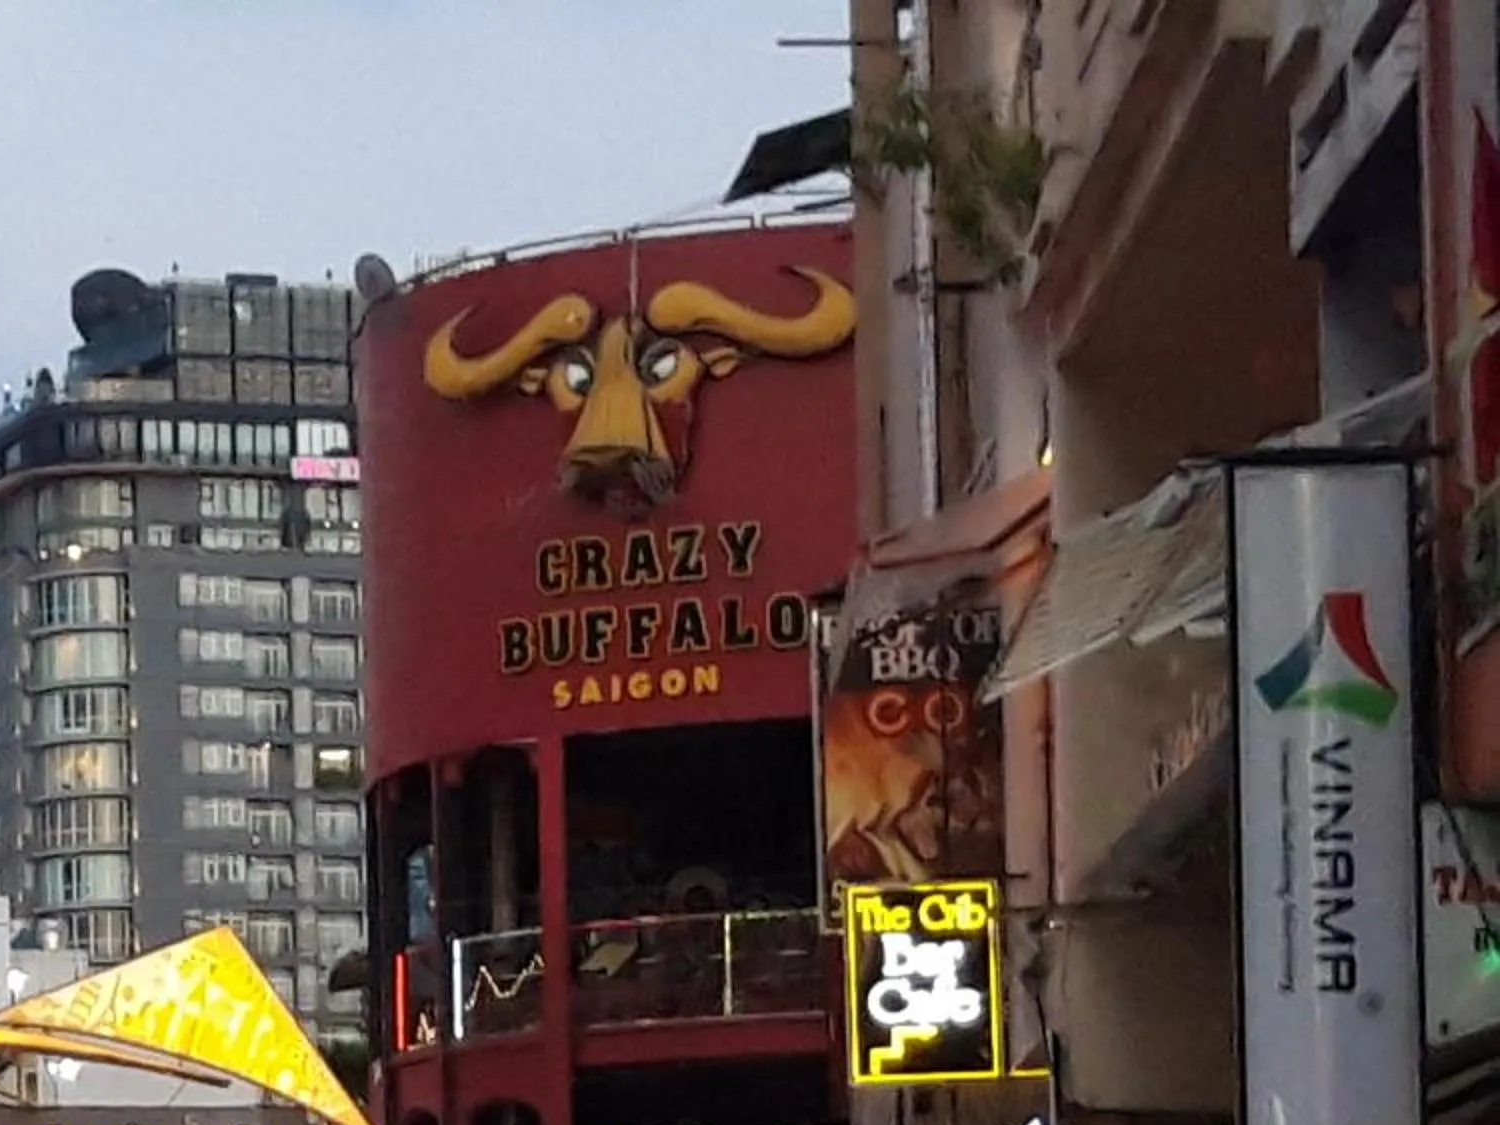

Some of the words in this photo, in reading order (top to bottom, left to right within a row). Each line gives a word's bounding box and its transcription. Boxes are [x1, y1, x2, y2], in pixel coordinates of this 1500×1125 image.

[537, 521, 761, 595] CRAZY
[500, 592, 809, 673] BUFFALO
[553, 664, 720, 709] SAIGON
[871, 646, 962, 682] BBQ
[856, 895, 912, 932] The
